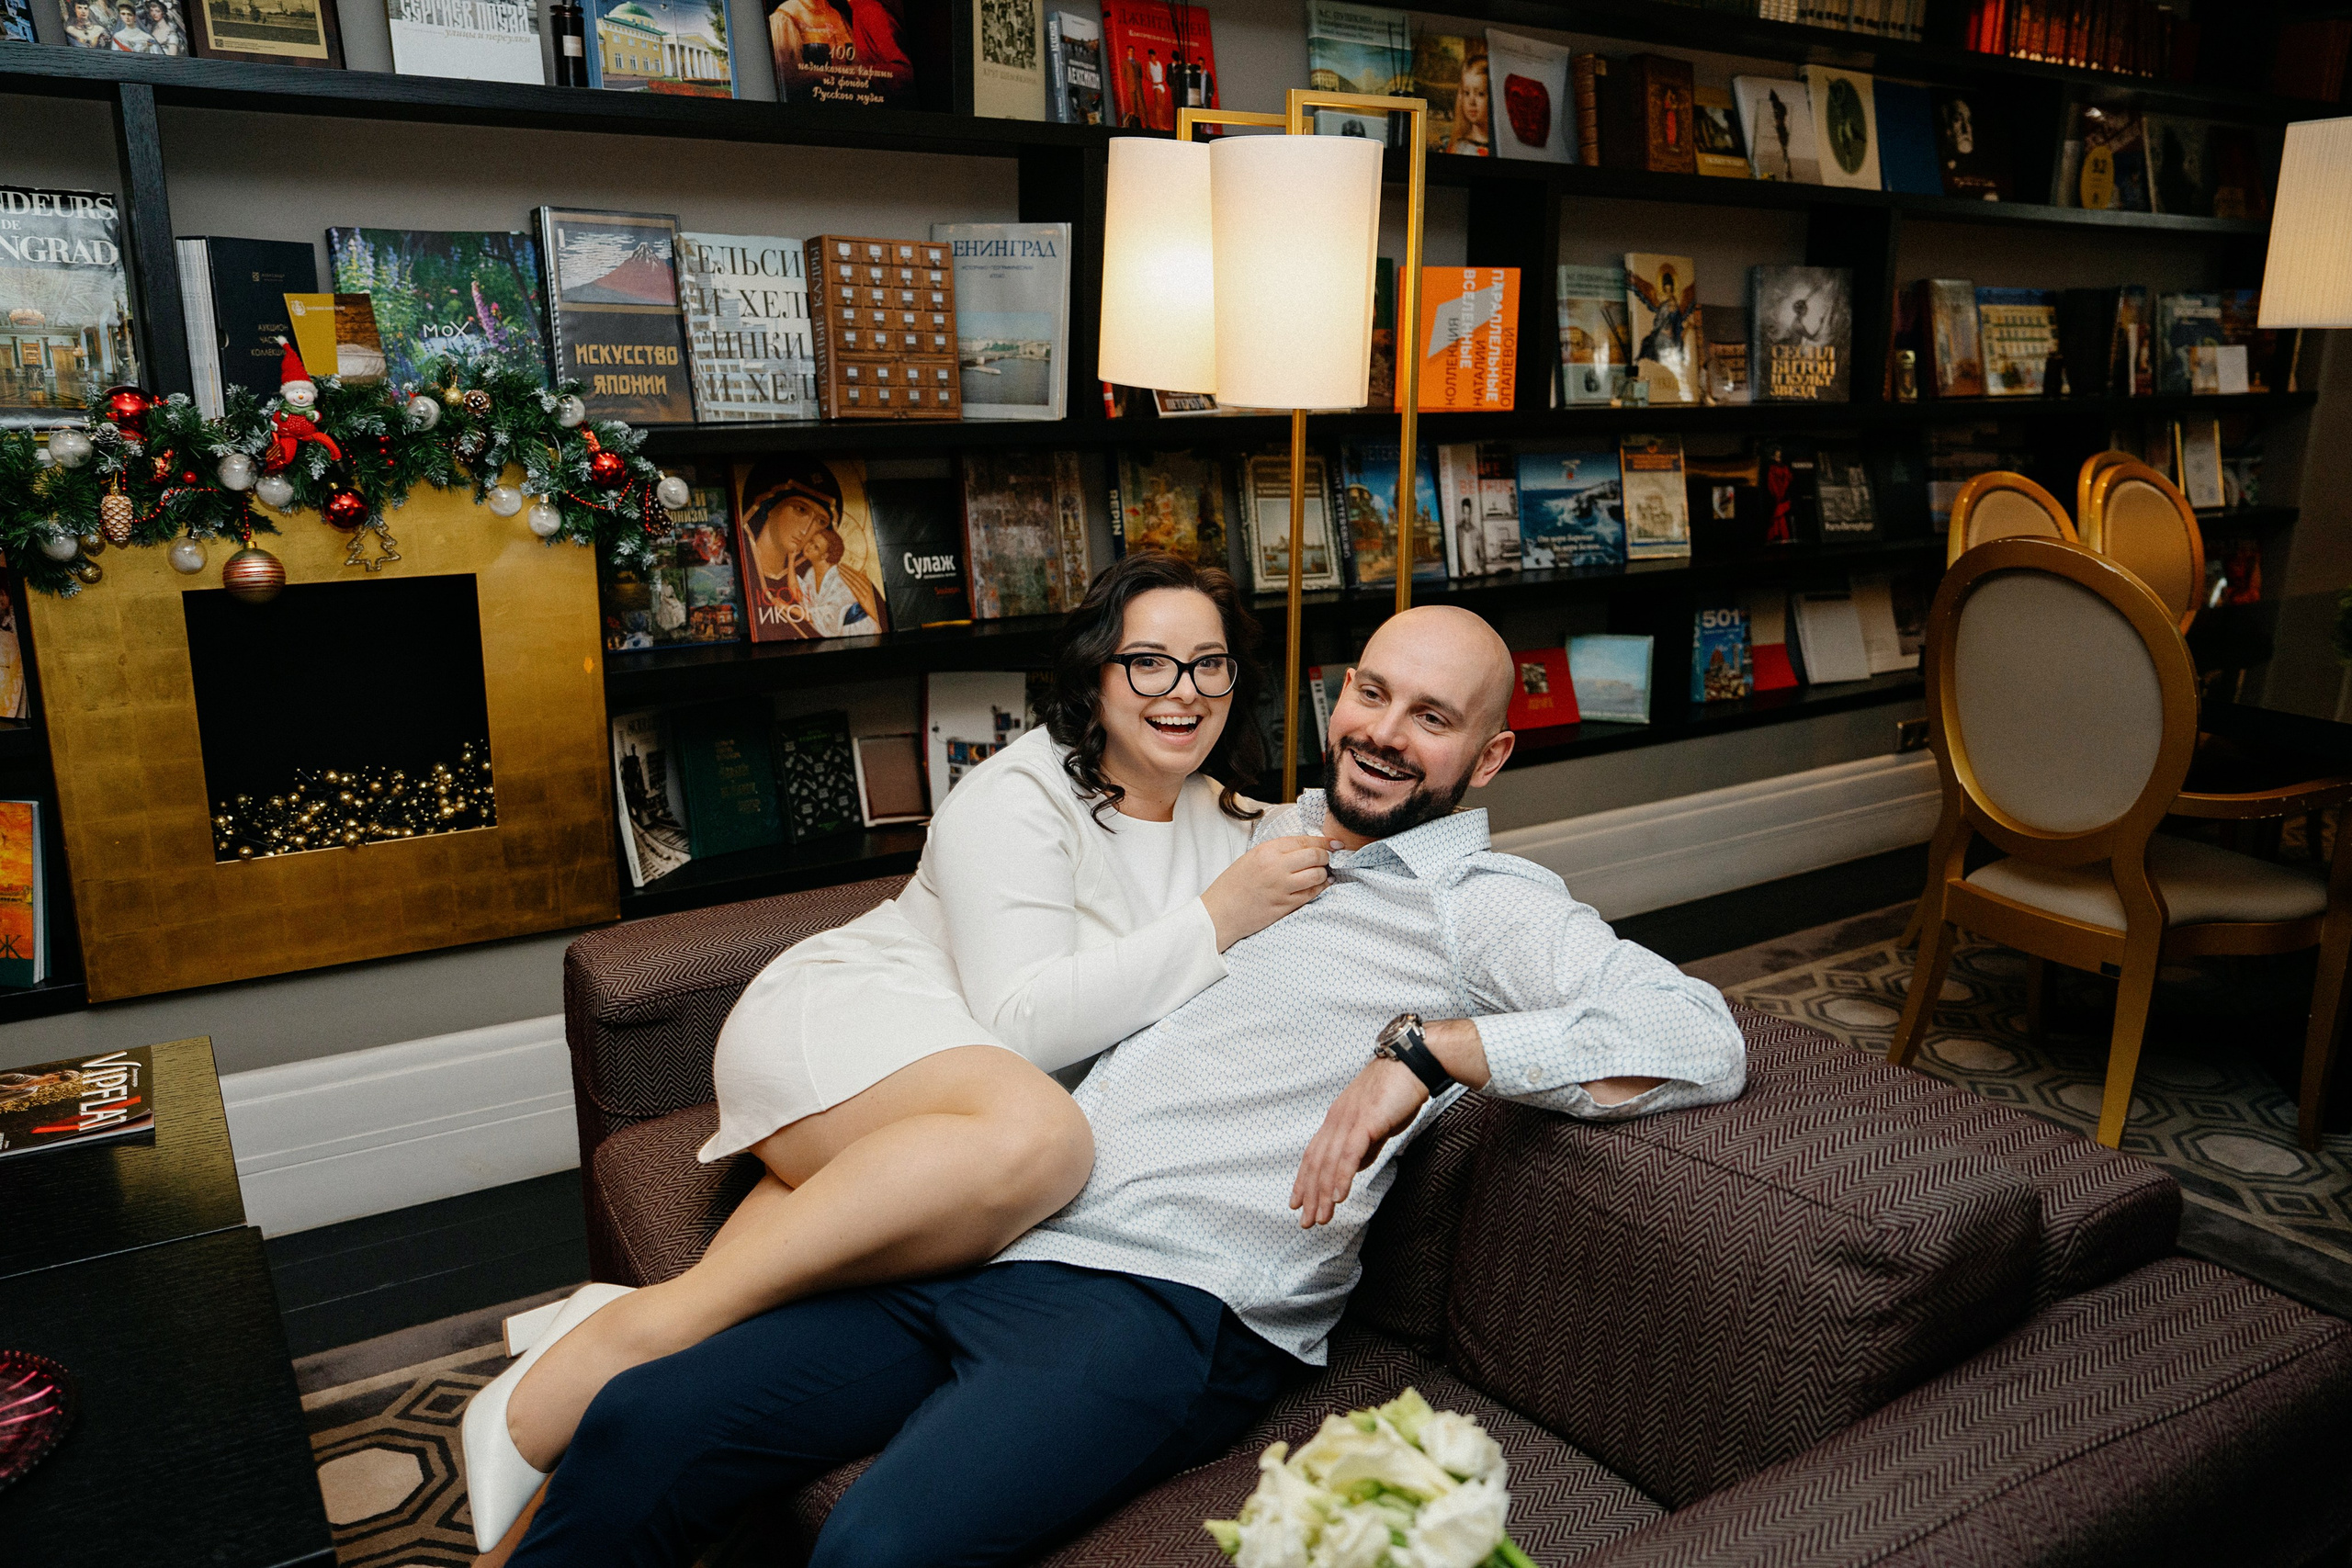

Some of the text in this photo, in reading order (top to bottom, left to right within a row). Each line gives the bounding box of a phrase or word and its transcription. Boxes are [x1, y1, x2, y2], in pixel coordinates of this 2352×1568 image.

[1118, 8, 1208, 37] ДЖЕНТЛЕН
[445, 28, 531, 44] улицы и переулки
[829, 45, 856, 62] 100
[797, 62, 894, 80] незнакомых картин
[822, 76, 870, 89] из фондов
[812, 86, 885, 106] Русского музея
[0, 190, 116, 220] DEURS
[2, 220, 21, 231] DE
[953, 240, 1057, 258] ЕНИНГРАД
[810, 245, 824, 308] КАДРЫ
[1459, 269, 1476, 368] ВСЕЛЕННЫЕ
[1486, 269, 1505, 401] ПАРАЛЛЕЛЬНЫЕ
[250, 348, 287, 357] КОЛЛЕКЦИ
[574, 344, 679, 366] ИСКУССТВО
[1445, 317, 1460, 406] КОЛЛЕКЦИЯ
[1473, 340, 1487, 406] НАТАЛИИ
[1500, 326, 1516, 407] ОПАЛЕВОЙ
[594, 374, 668, 396] ЯПОНИИ
[664, 509, 708, 524] ОНИЗМ
[1109, 489, 1122, 536] REPIN
[903, 552, 956, 580] Сулаж
[1702, 608, 1740, 629] 501
